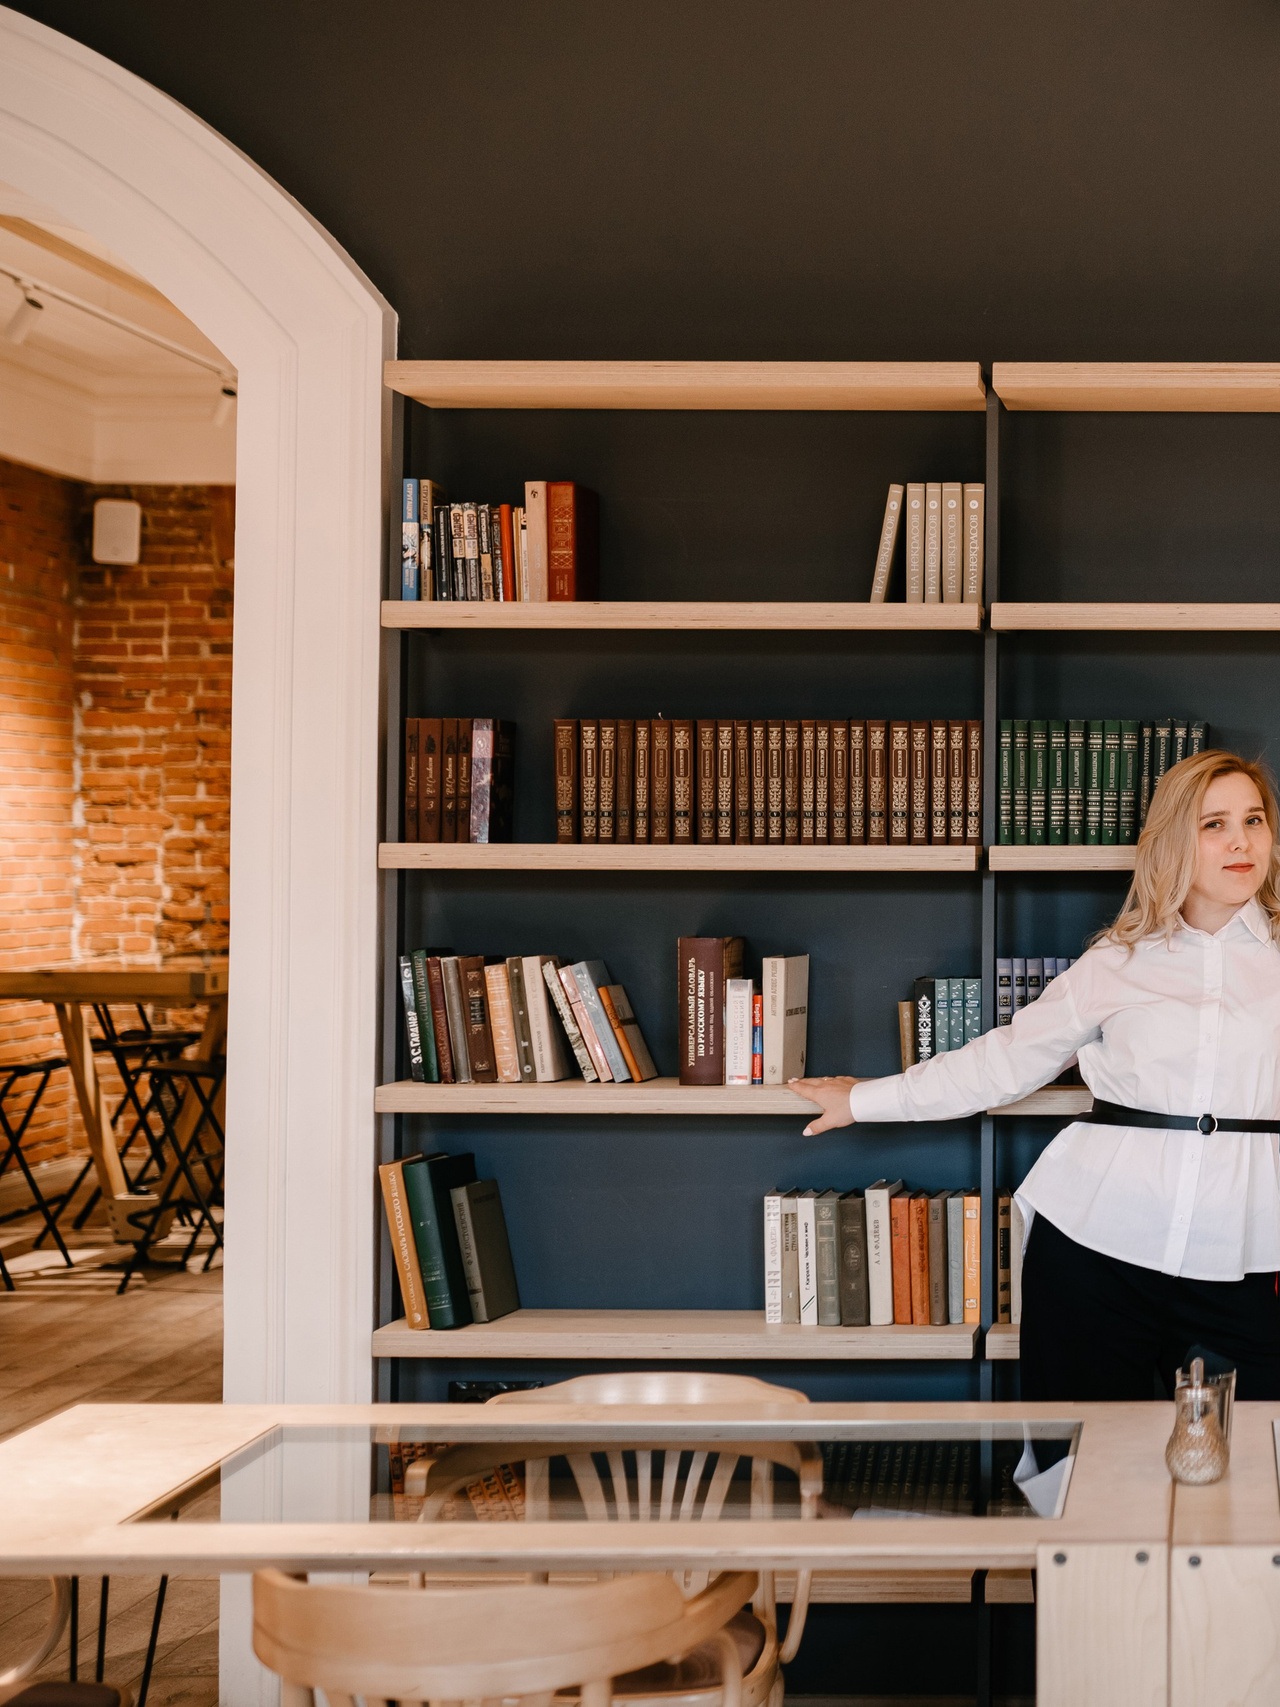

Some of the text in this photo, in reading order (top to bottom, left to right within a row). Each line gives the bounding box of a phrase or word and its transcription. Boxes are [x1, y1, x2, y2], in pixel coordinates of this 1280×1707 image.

[427, 800, 435, 809] 3
[446, 800, 453, 809] 4
[688, 957, 696, 1067] УНИВЕРСАЛЬНЫЙ СЛОВАРЬ
[697, 969, 705, 1057] ПО РУССКОМУ ЯЗЫКУ
[388, 1171, 410, 1271] СЛОВАРЬ РУССКОГО ЯЗЫКА
[456, 1202, 470, 1251] ДОСТОЕВСКИЙ
